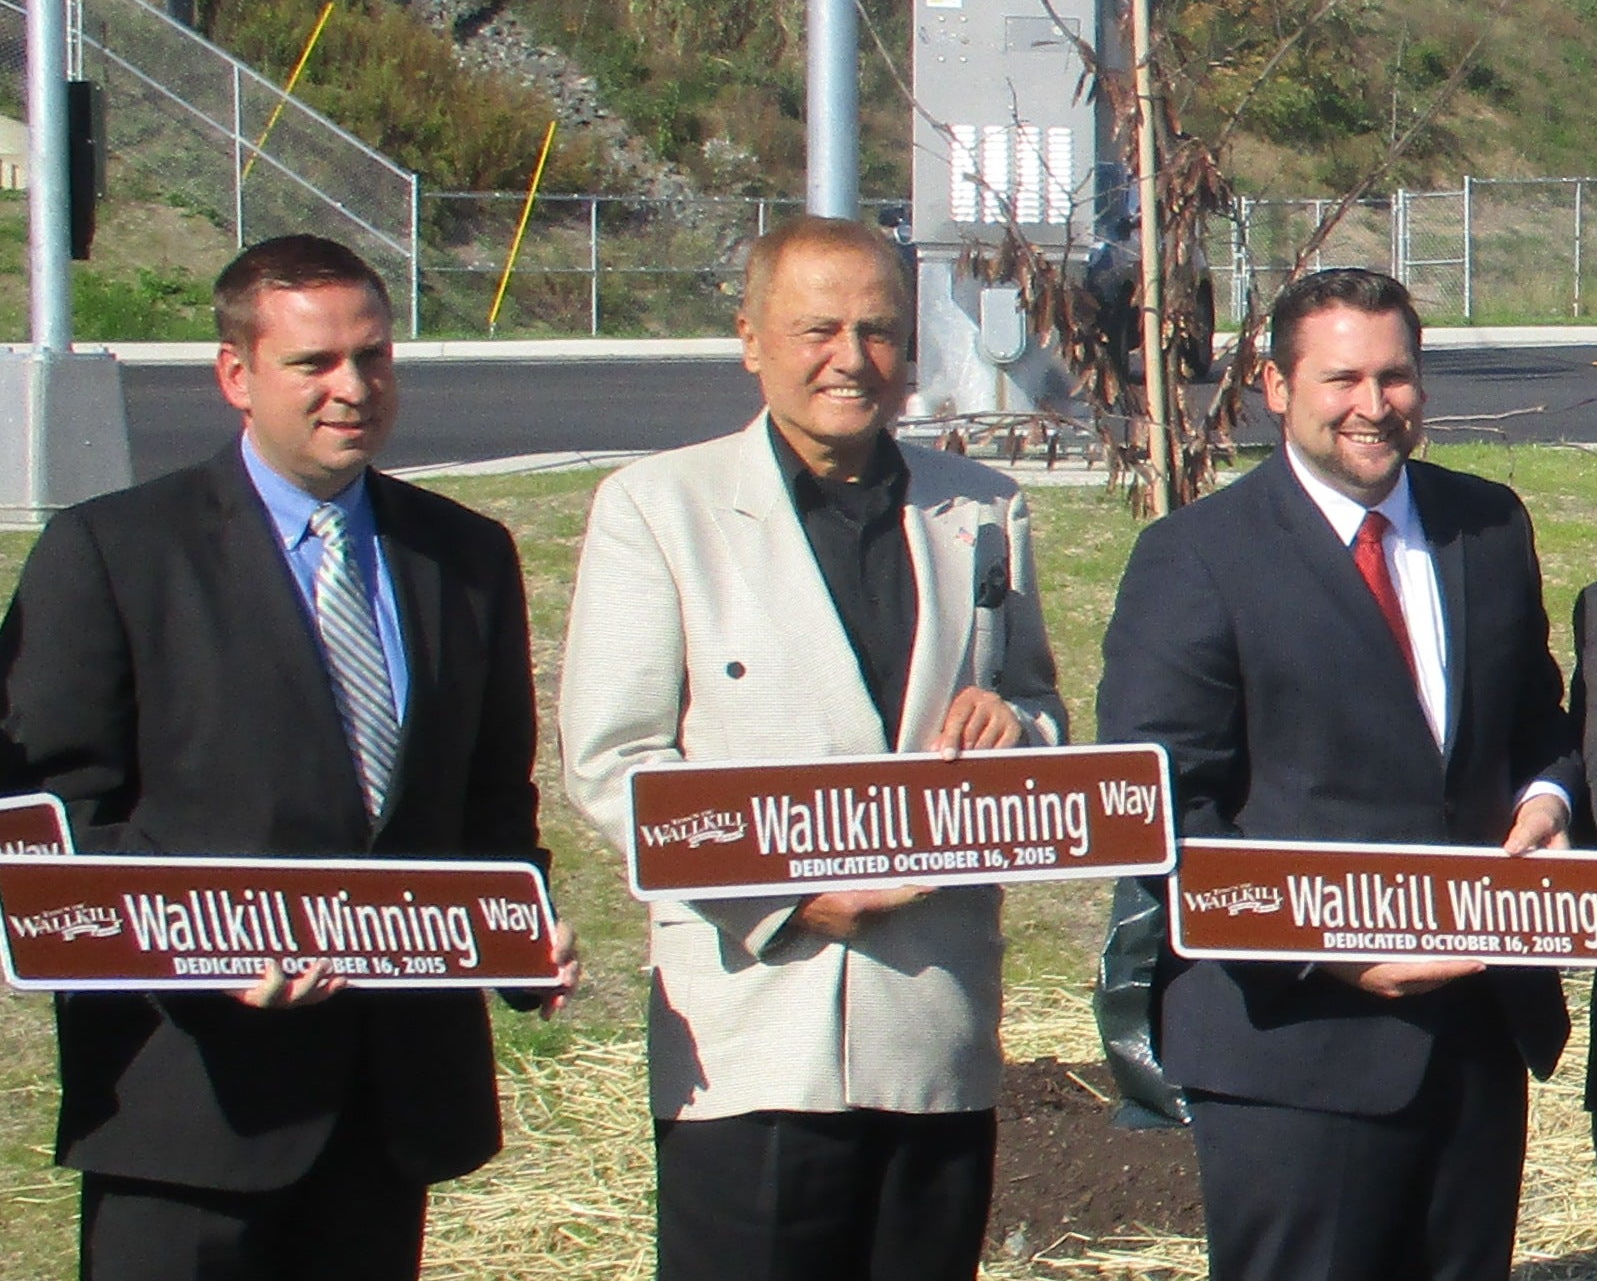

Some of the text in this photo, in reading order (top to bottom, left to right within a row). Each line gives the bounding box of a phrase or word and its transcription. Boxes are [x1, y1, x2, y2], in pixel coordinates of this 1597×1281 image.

[751, 778, 1157, 856] Wallkill Winning Way
[789, 847, 1056, 879] DEDICATED OCTOBER 16, 2015
[1287, 873, 1437, 931] Wallkill
[123, 889, 540, 967] Wallkill Winning Way
[1324, 931, 1572, 954] DEDICATED OCTOBER 16, 2015
[372, 957, 400, 976] 16,
[403, 957, 446, 974] 2015
